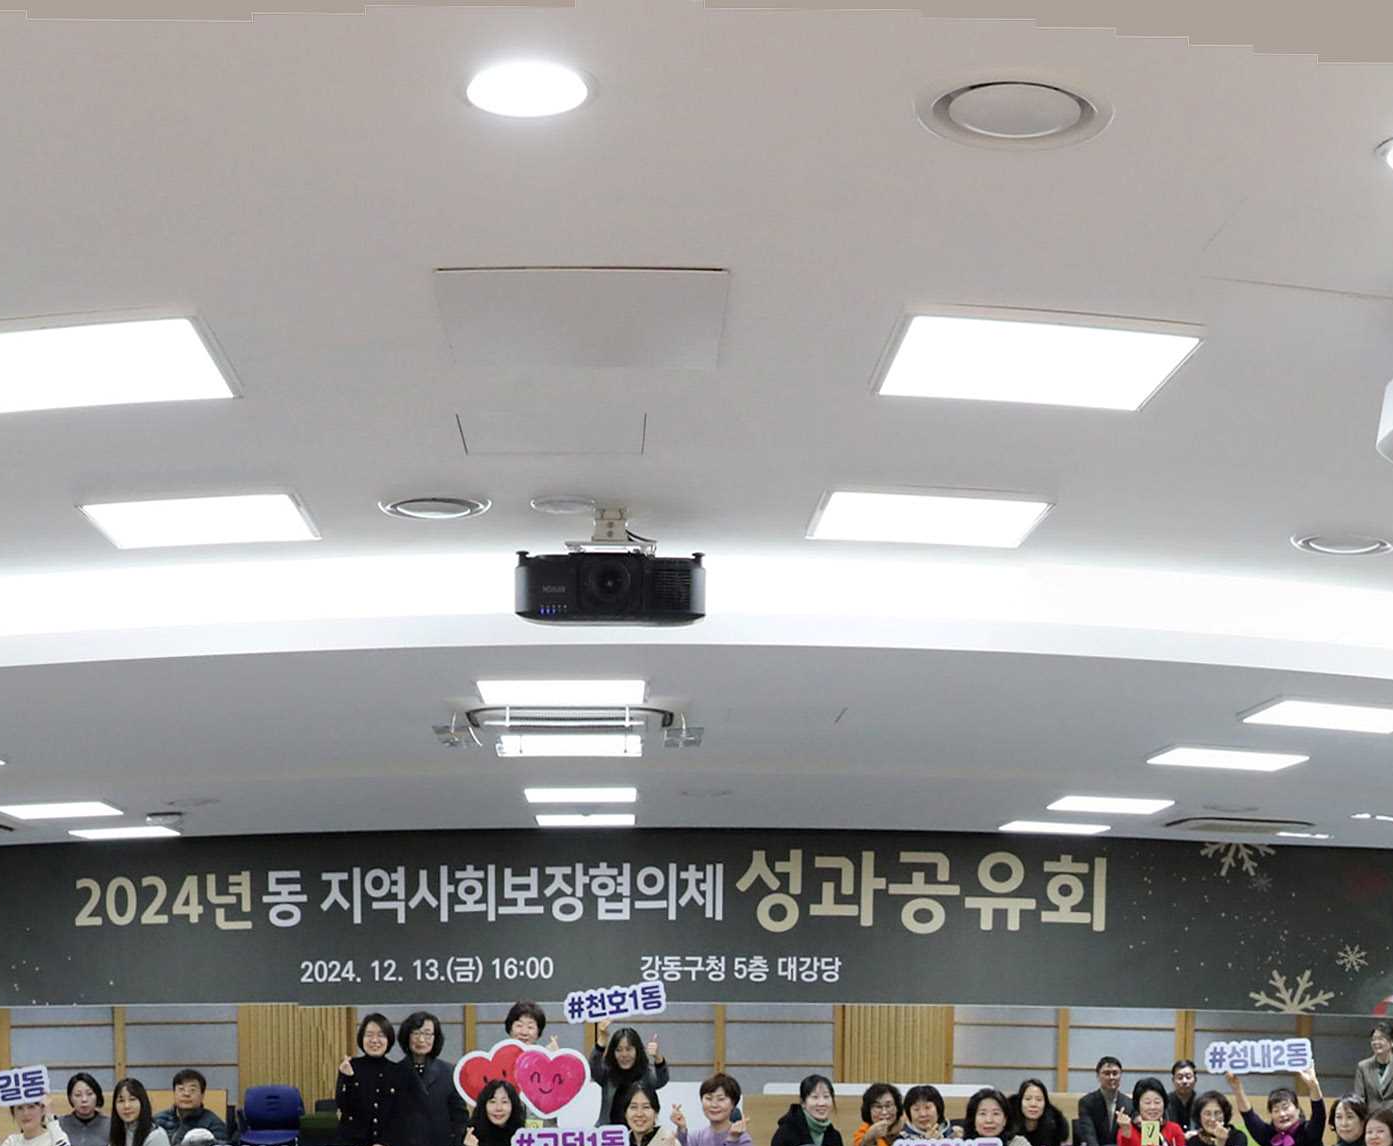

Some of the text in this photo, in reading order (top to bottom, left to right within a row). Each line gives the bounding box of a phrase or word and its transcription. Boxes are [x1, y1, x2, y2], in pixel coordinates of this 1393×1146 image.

[74, 849, 1106, 934] 2024년 동 지역사회보장협의체 성과공유회
[300, 956, 554, 983] 2024. 12. 13.(금) 16:00
[640, 956, 842, 983] 강동구청 5층 대강당
[568, 985, 662, 1019] #천호1동
[1209, 1042, 1308, 1070] #성내2동
